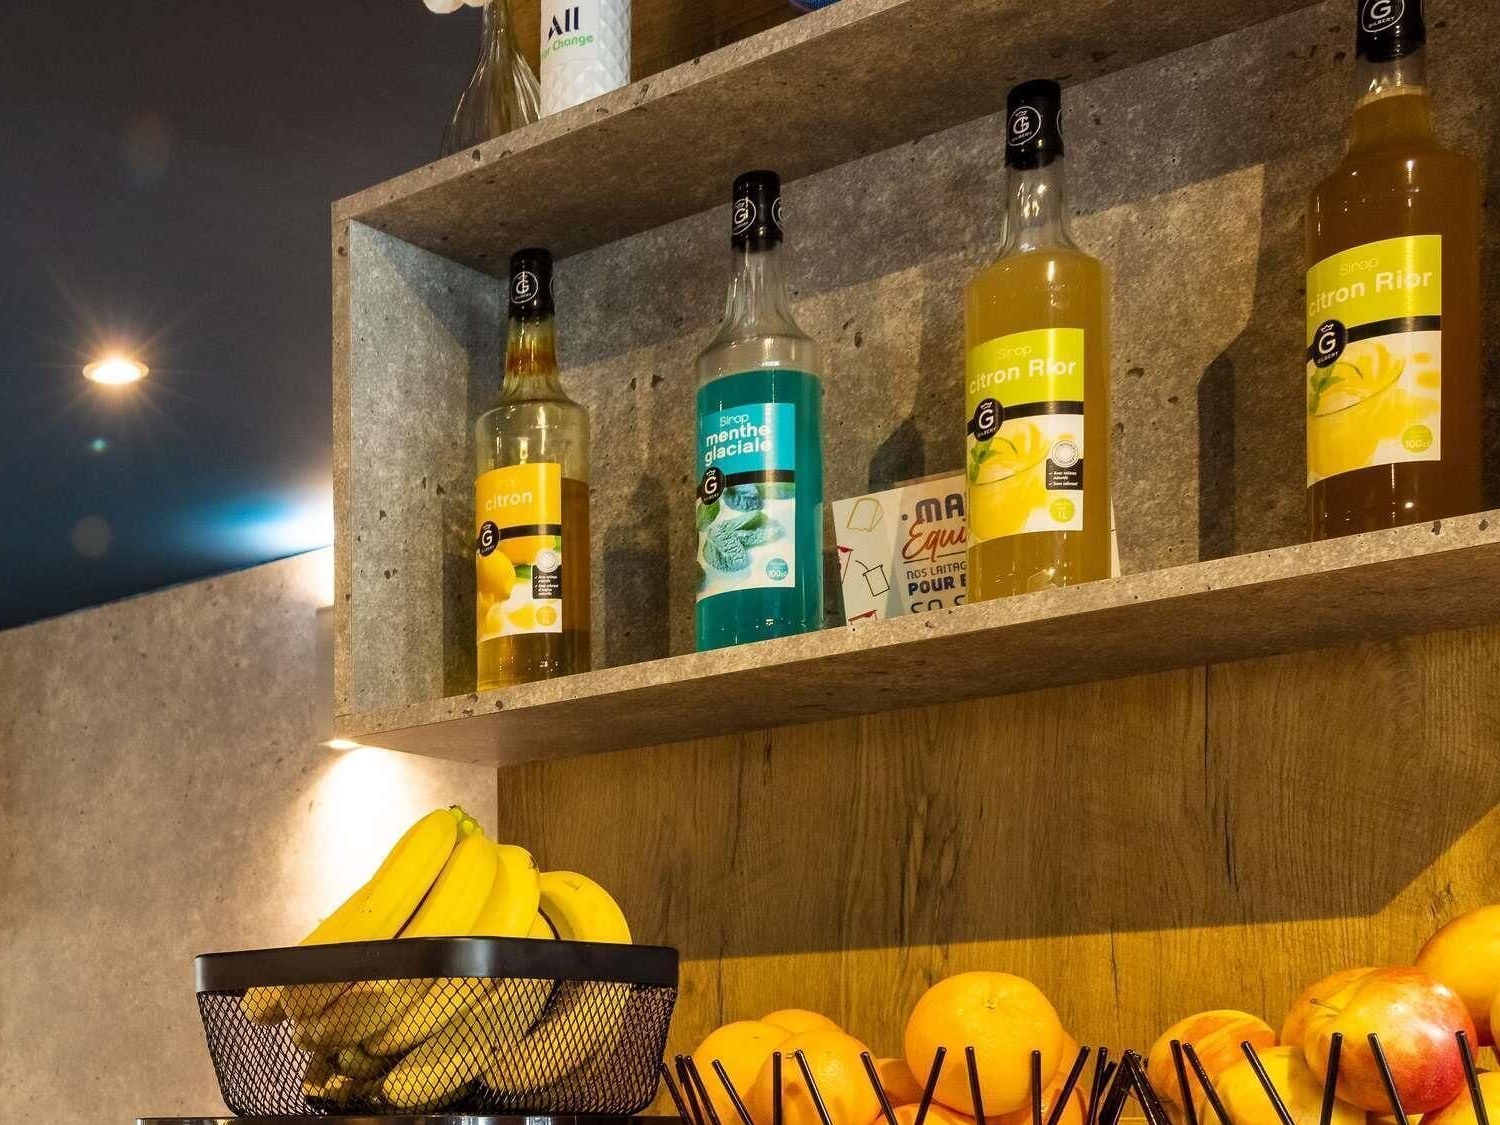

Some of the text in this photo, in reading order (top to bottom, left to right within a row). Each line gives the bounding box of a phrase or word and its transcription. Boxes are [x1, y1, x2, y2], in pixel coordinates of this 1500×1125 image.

[547, 6, 579, 41] All
[553, 34, 595, 51] Change
[1339, 257, 1380, 276] Sirop
[1308, 269, 1433, 318] citron Rior
[997, 344, 1032, 361] Sirop
[1318, 331, 1336, 355] G
[969, 357, 1077, 395] citron Rior
[720, 413, 750, 427] Sirop
[978, 409, 994, 430] G
[706, 422, 771, 448] menthe
[704, 437, 773, 467] glaciale
[704, 475, 718, 495] G
[484, 491, 533, 513] citron
[915, 492, 966, 523] MA
[481, 529, 493, 547] G
[907, 575, 956, 597] POUR
